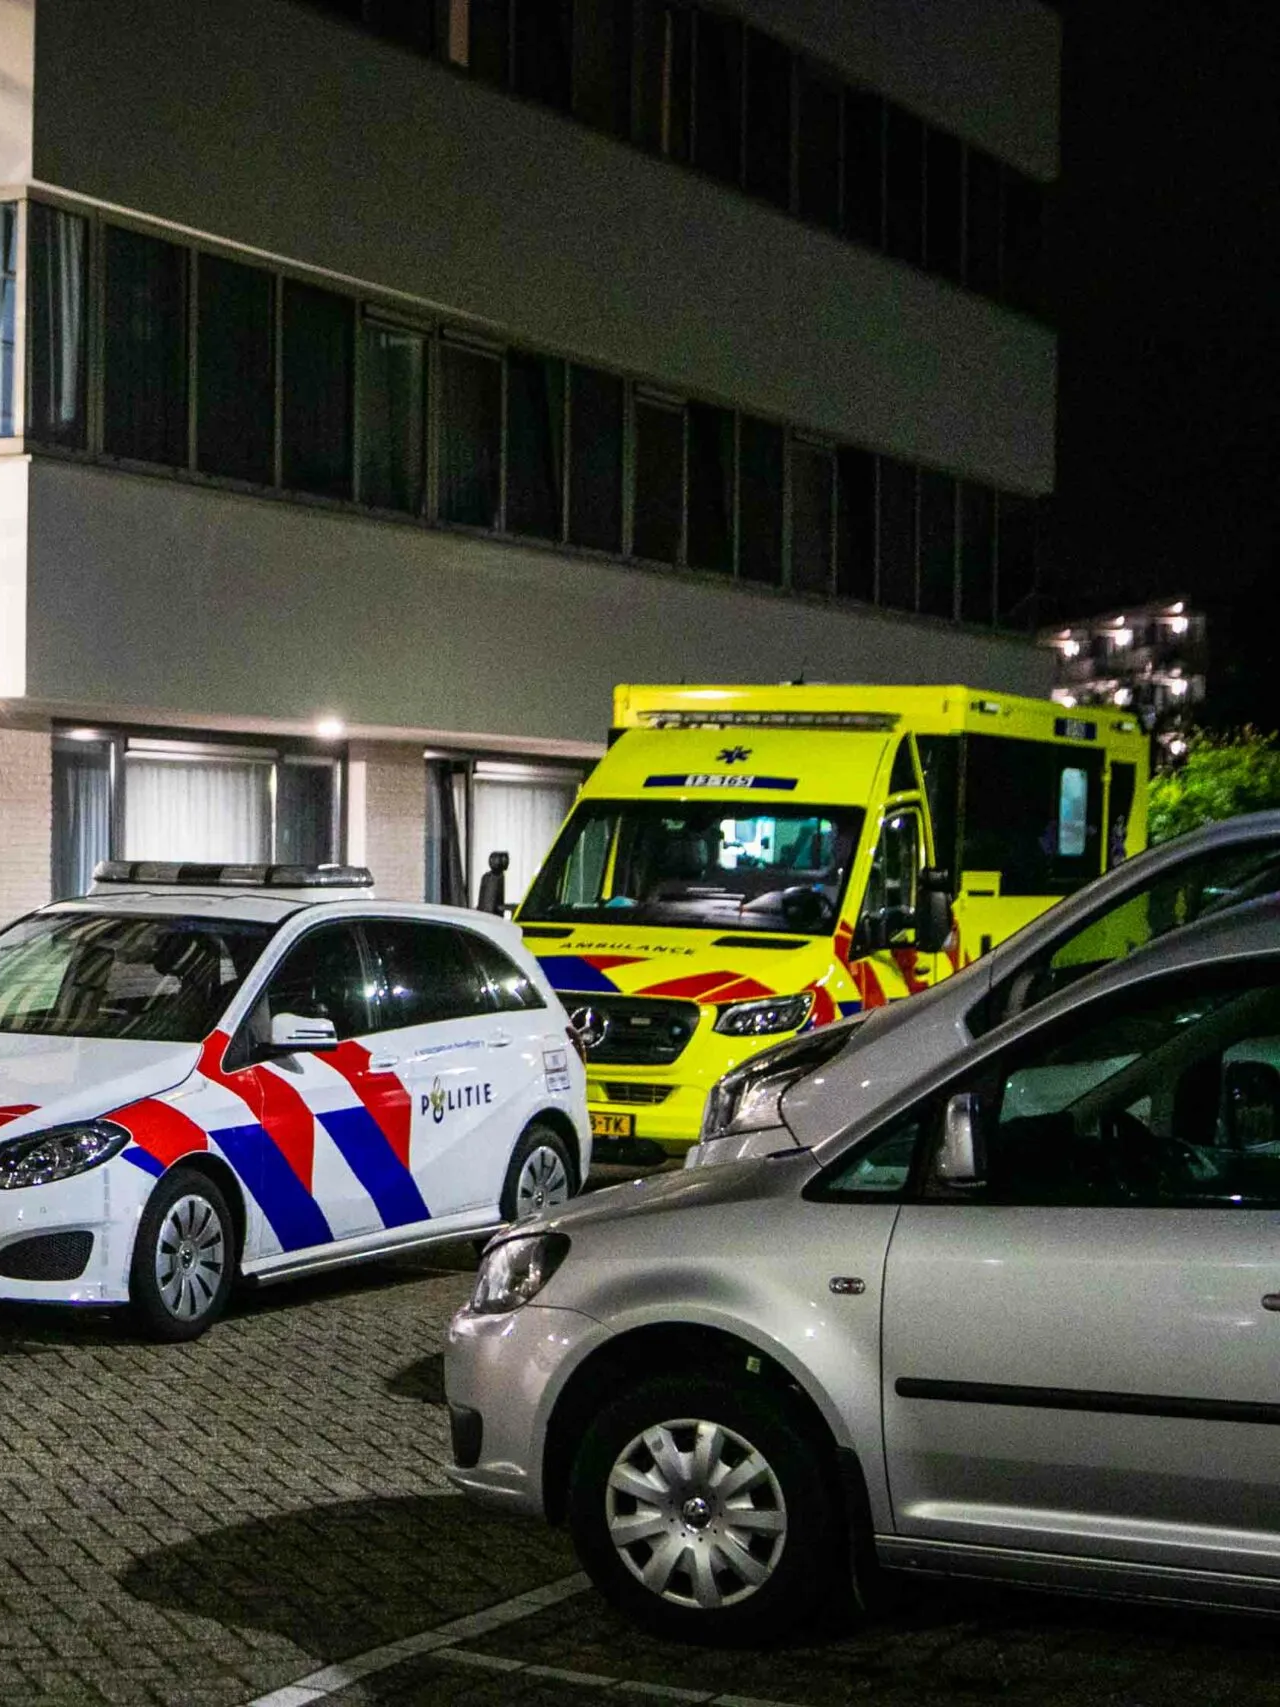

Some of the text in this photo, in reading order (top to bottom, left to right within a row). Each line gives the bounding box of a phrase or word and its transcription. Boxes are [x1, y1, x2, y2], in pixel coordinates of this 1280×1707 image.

[690, 775, 750, 786] 13-165
[559, 942, 696, 956] AMBULANCE
[421, 1074, 493, 1125] POLITIE
